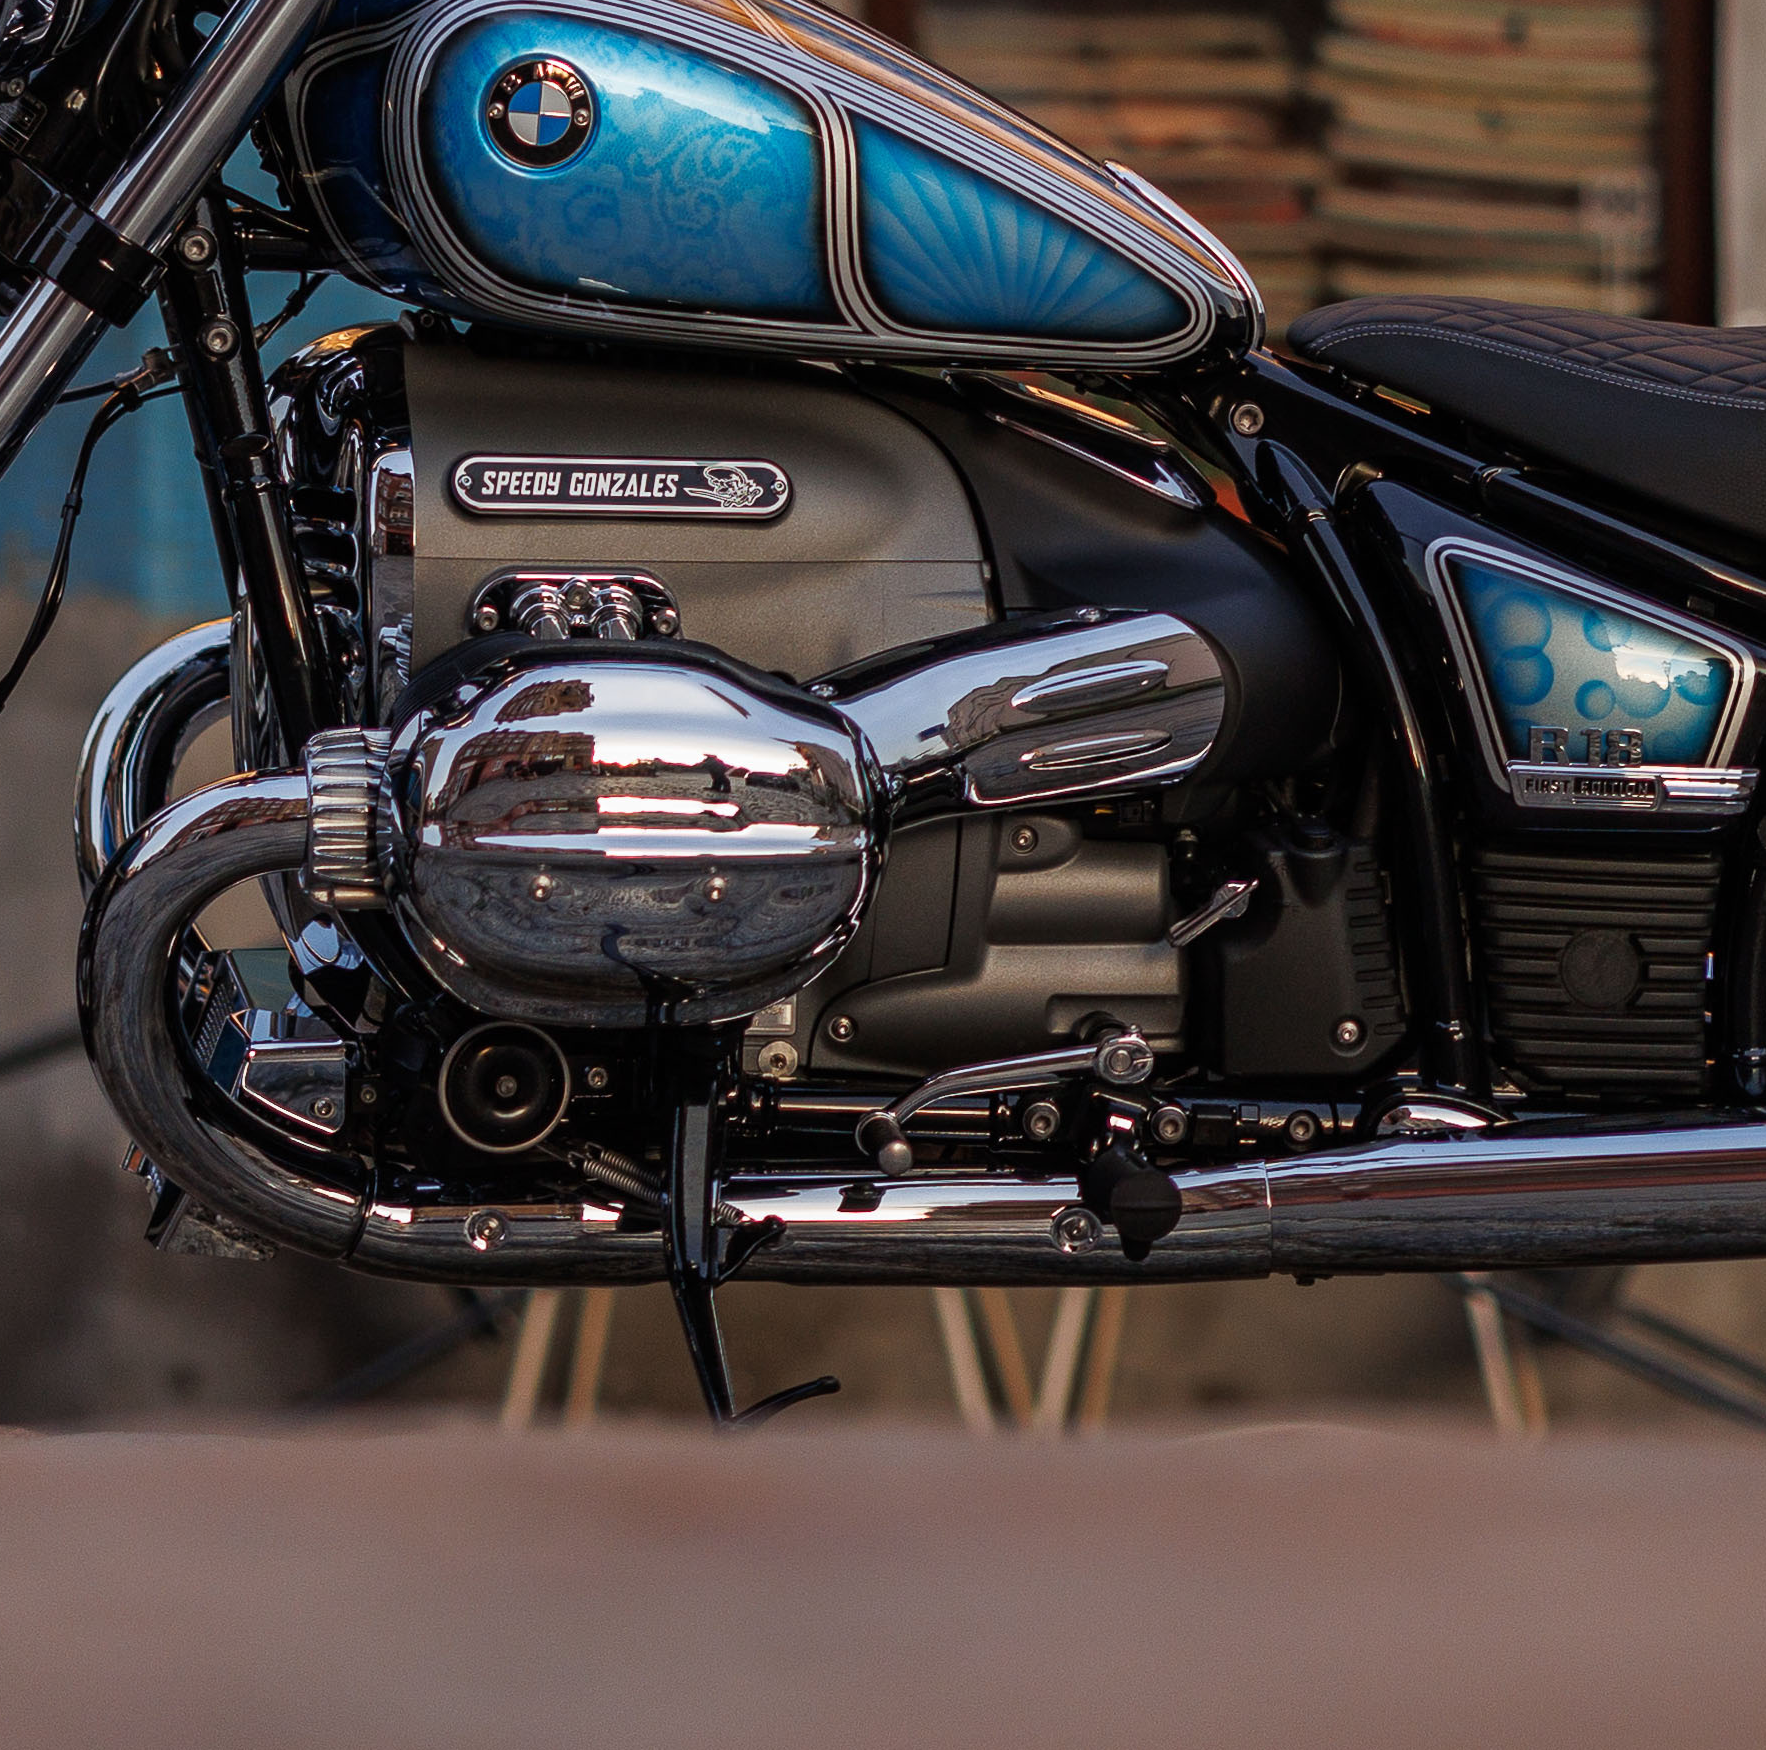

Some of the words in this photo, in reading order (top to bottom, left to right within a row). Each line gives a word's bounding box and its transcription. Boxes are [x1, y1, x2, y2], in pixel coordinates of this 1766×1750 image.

[481, 470, 562, 496] SPEEDY
[569, 472, 679, 498] GONZALES
[1524, 777, 1572, 795] FIRST
[1579, 780, 1649, 798] EDITION
